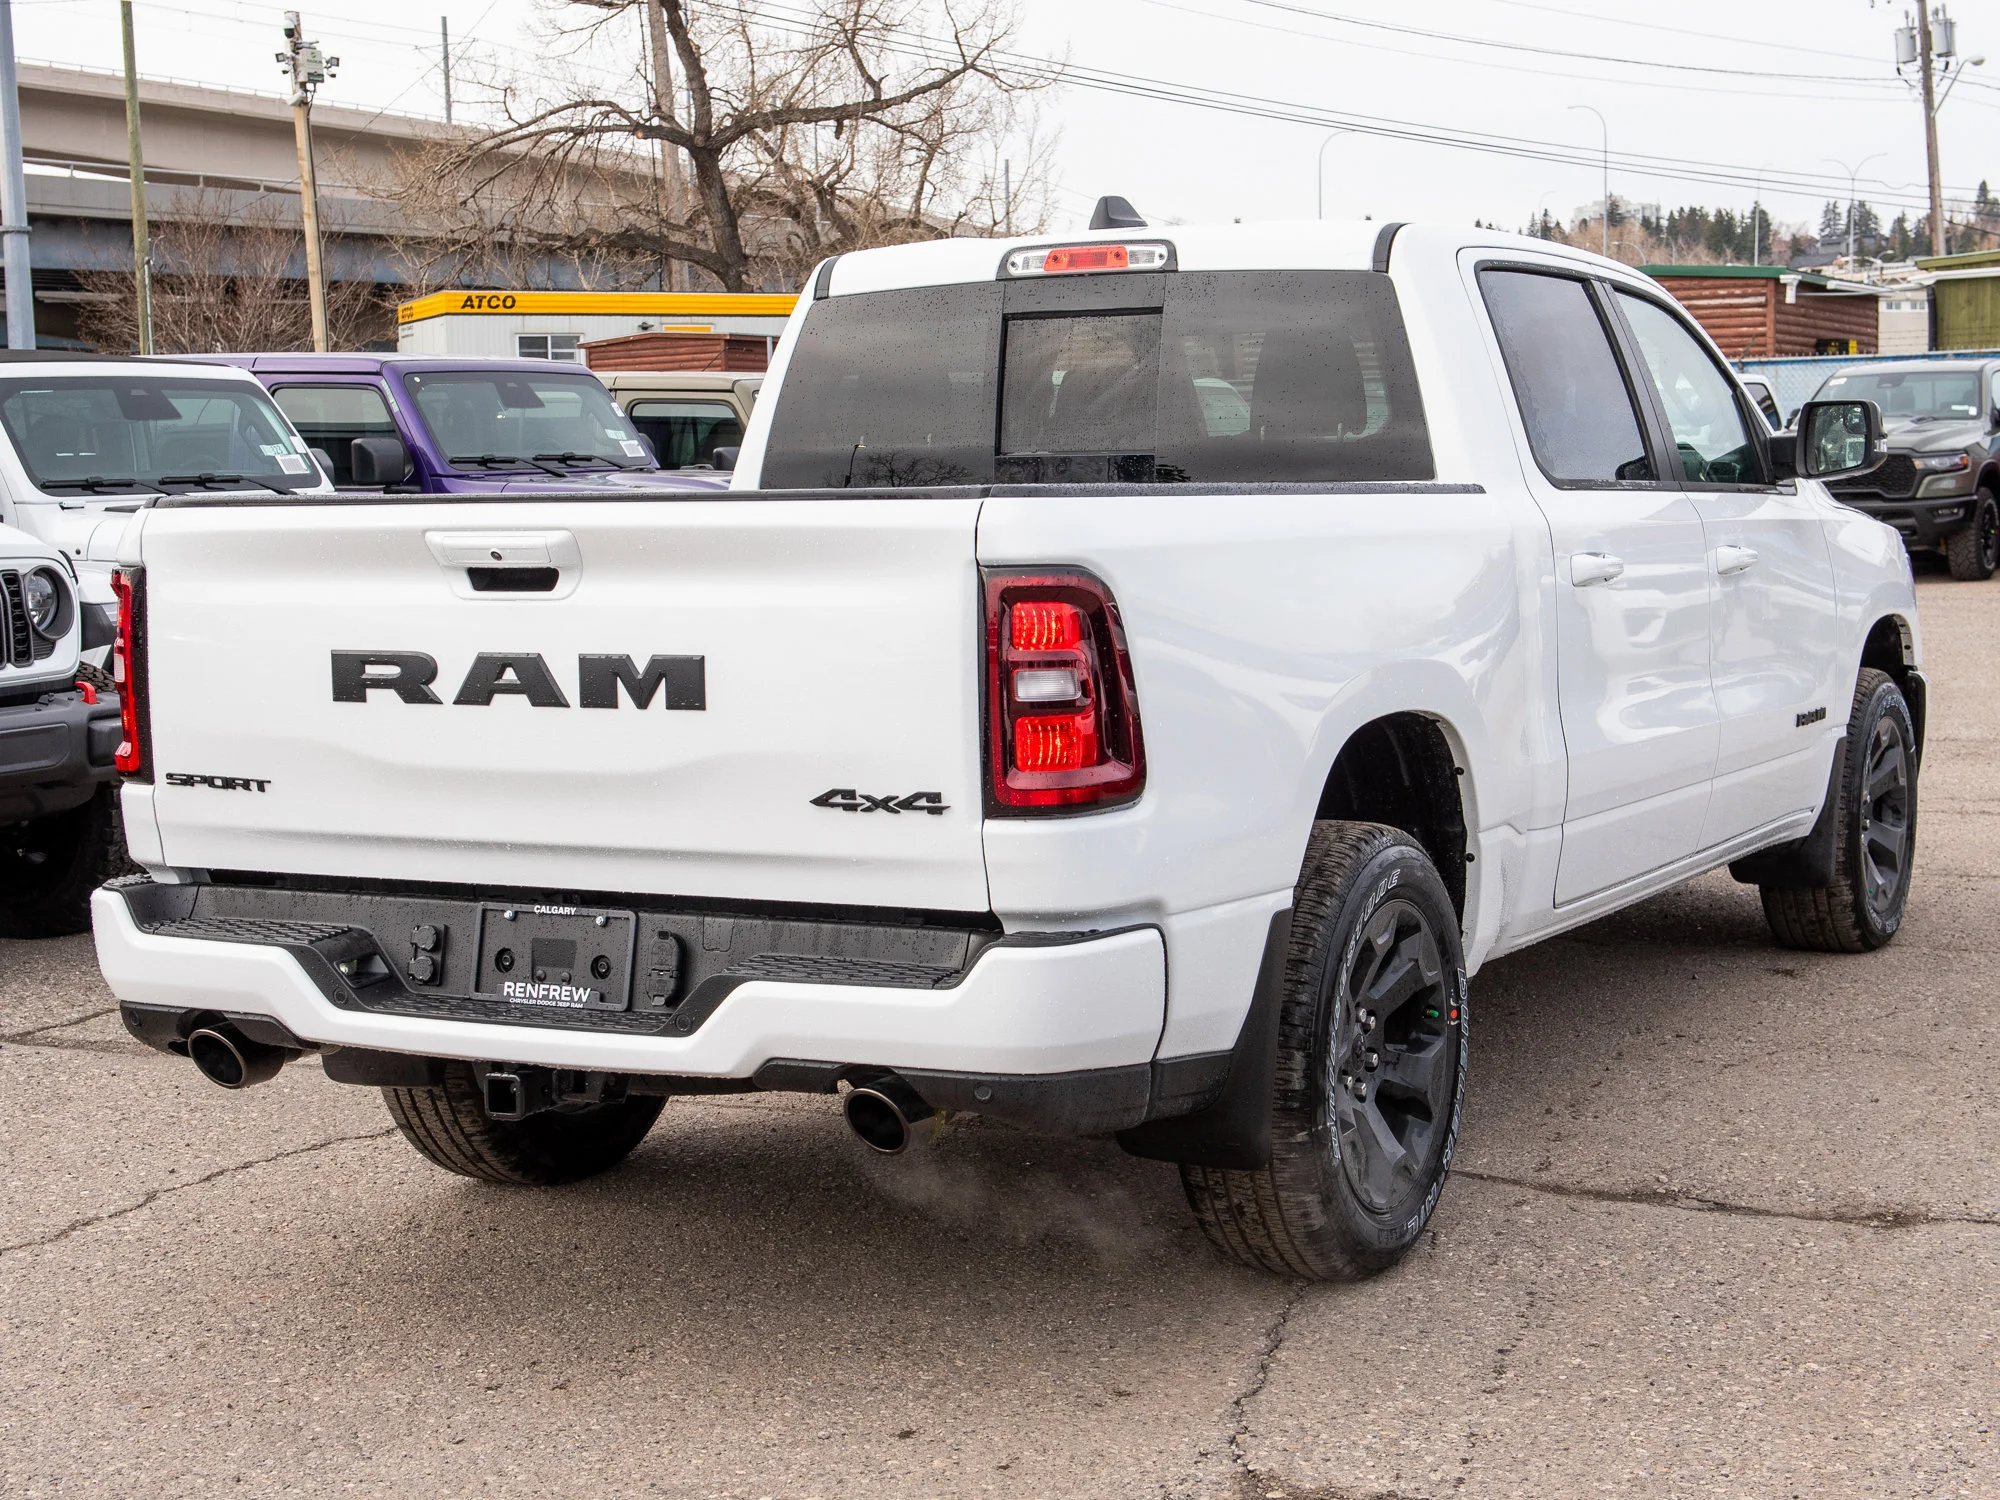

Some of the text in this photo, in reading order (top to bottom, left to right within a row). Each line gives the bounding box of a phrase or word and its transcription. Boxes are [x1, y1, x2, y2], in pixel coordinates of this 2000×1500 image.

[461, 295, 516, 310] ATCO
[331, 650, 706, 711] RAM
[166, 772, 271, 793] SPORT
[533, 904, 577, 915] CALGARY
[503, 981, 591, 1003] RENFREW
[509, 997, 537, 1005] CHRYSLER
